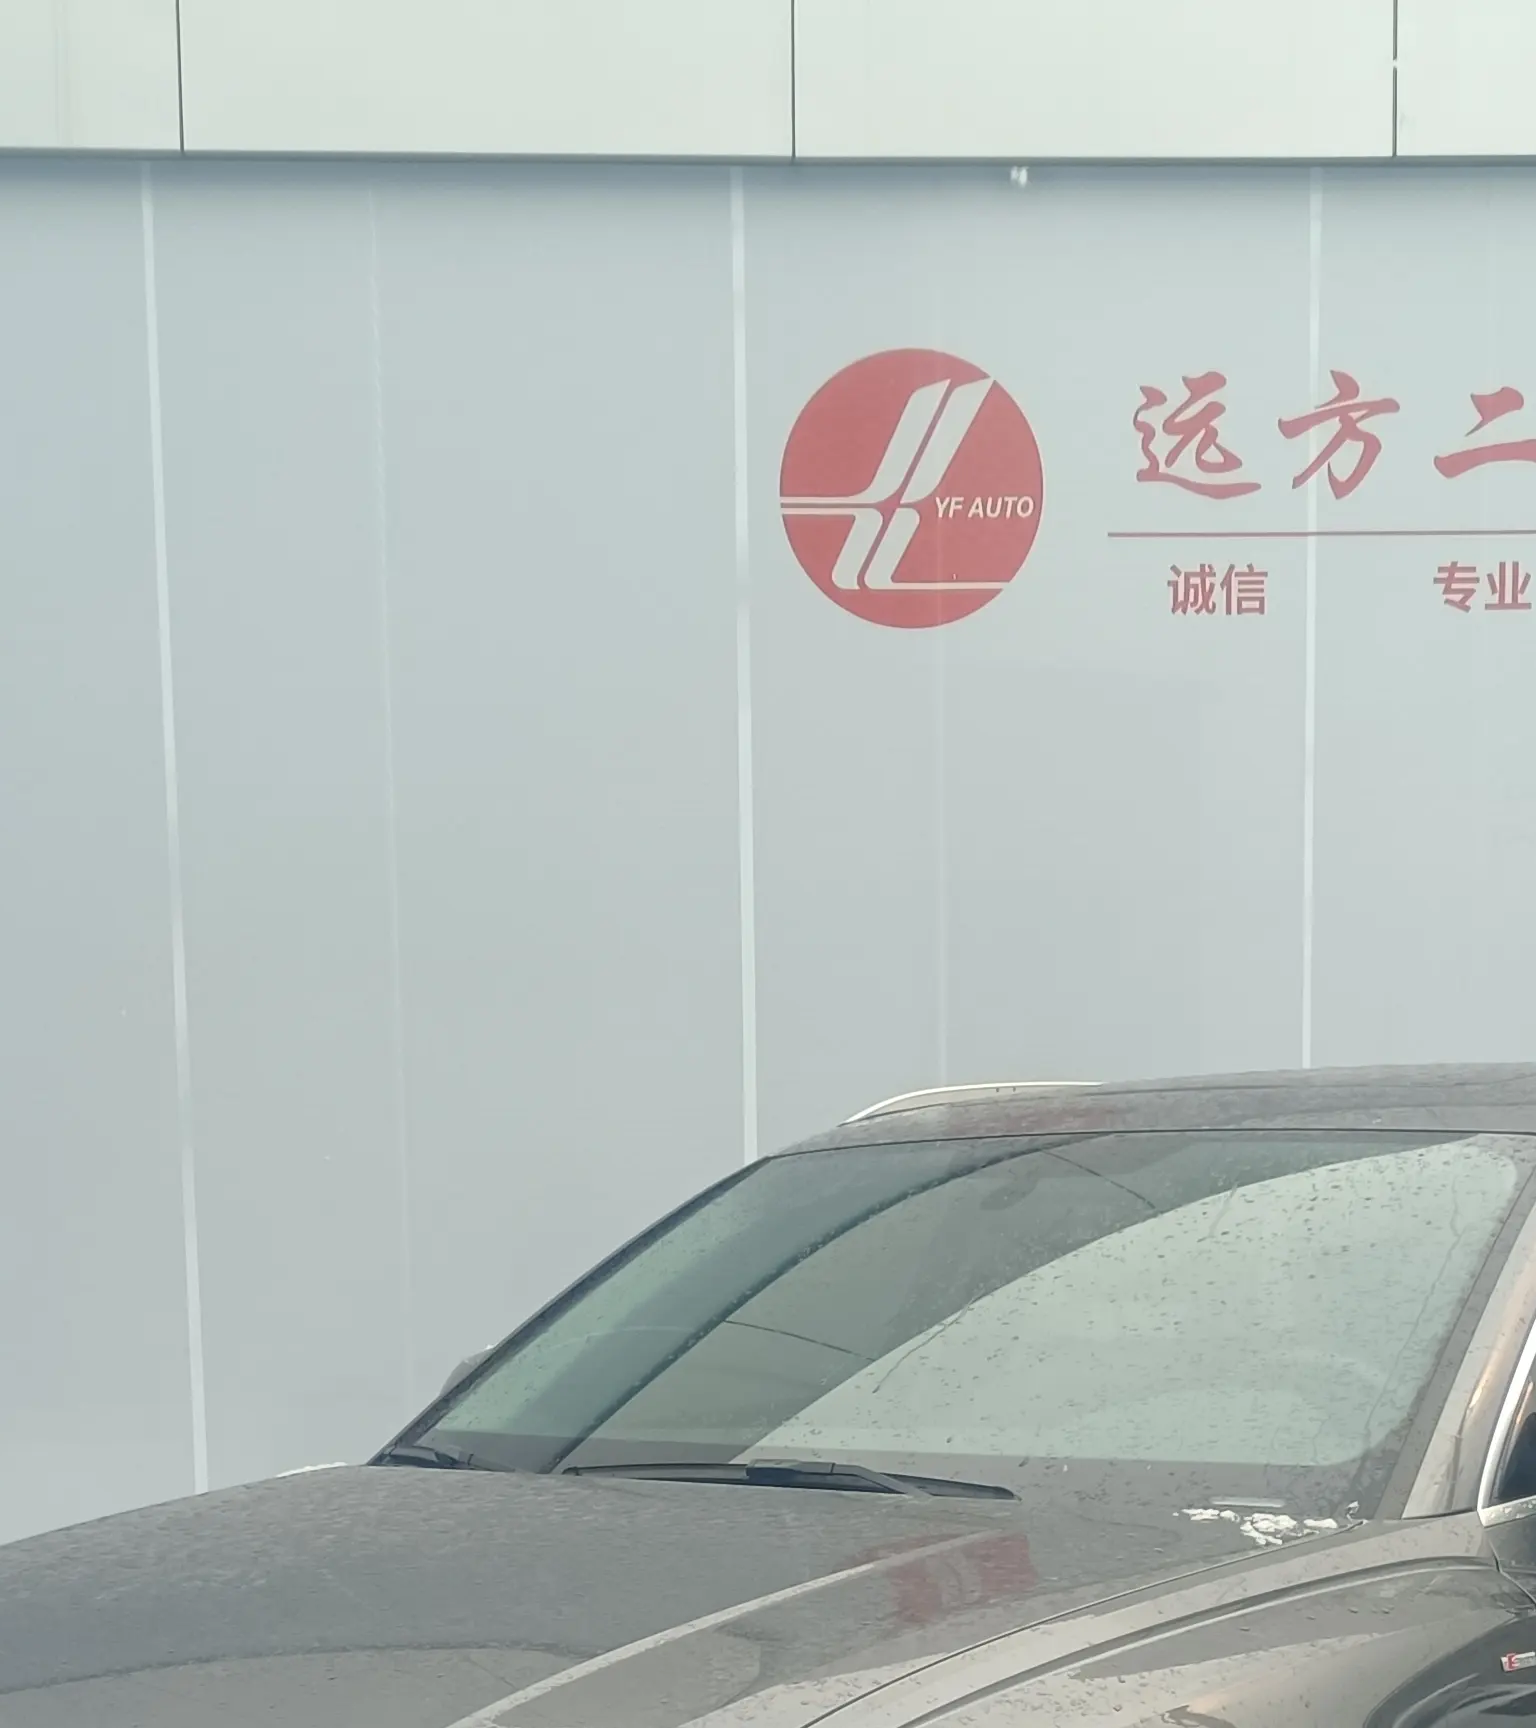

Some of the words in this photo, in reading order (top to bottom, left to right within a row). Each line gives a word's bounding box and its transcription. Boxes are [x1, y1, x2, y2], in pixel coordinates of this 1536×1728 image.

[935, 496, 965, 519] YF
[967, 495, 1035, 519] AUTO
[1167, 562, 1269, 616] 诚信
[1432, 560, 1533, 613] 专业
